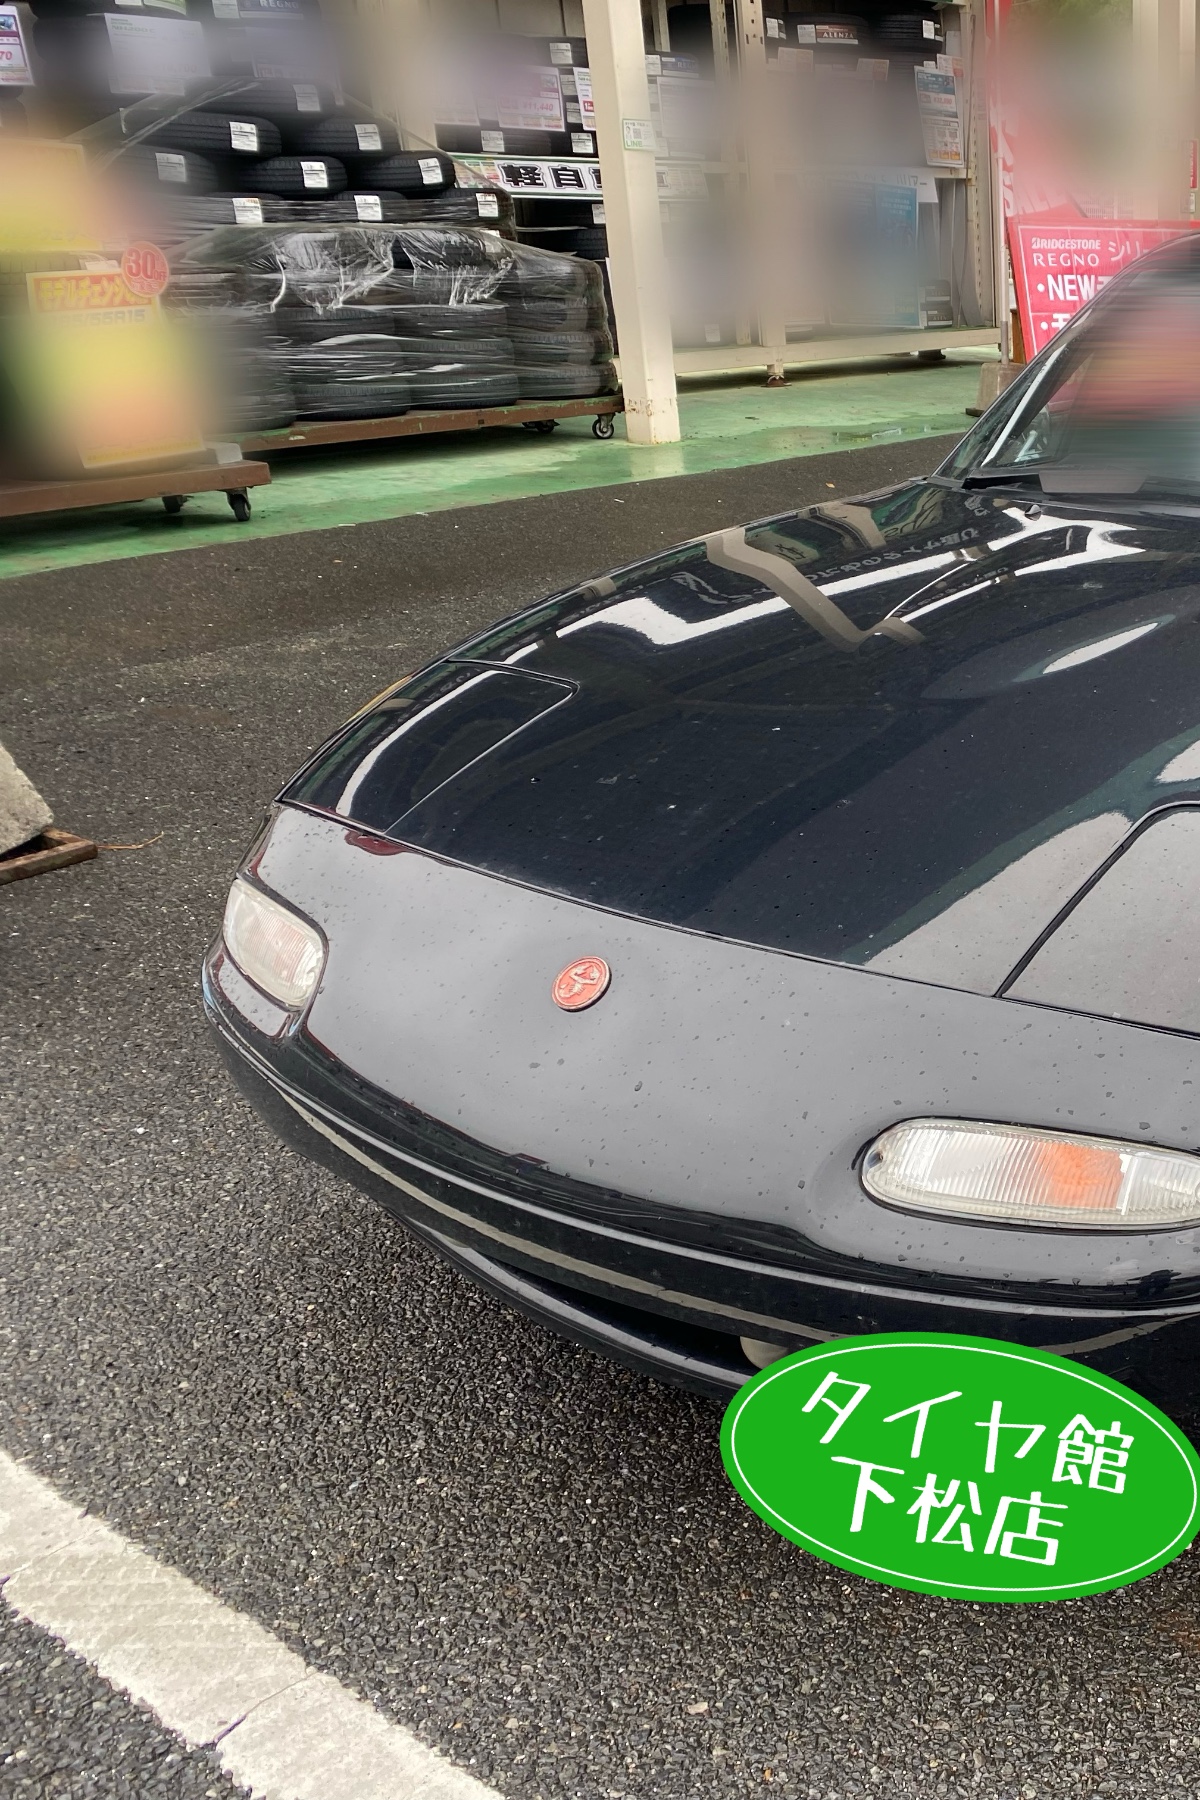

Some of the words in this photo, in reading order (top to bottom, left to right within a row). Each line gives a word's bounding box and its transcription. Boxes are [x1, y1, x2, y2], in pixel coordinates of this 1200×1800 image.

[822, 31, 854, 39] ALENZA
[1031, 236, 1101, 250] BRIDGESTONE
[1032, 253, 1100, 267] REGNO
